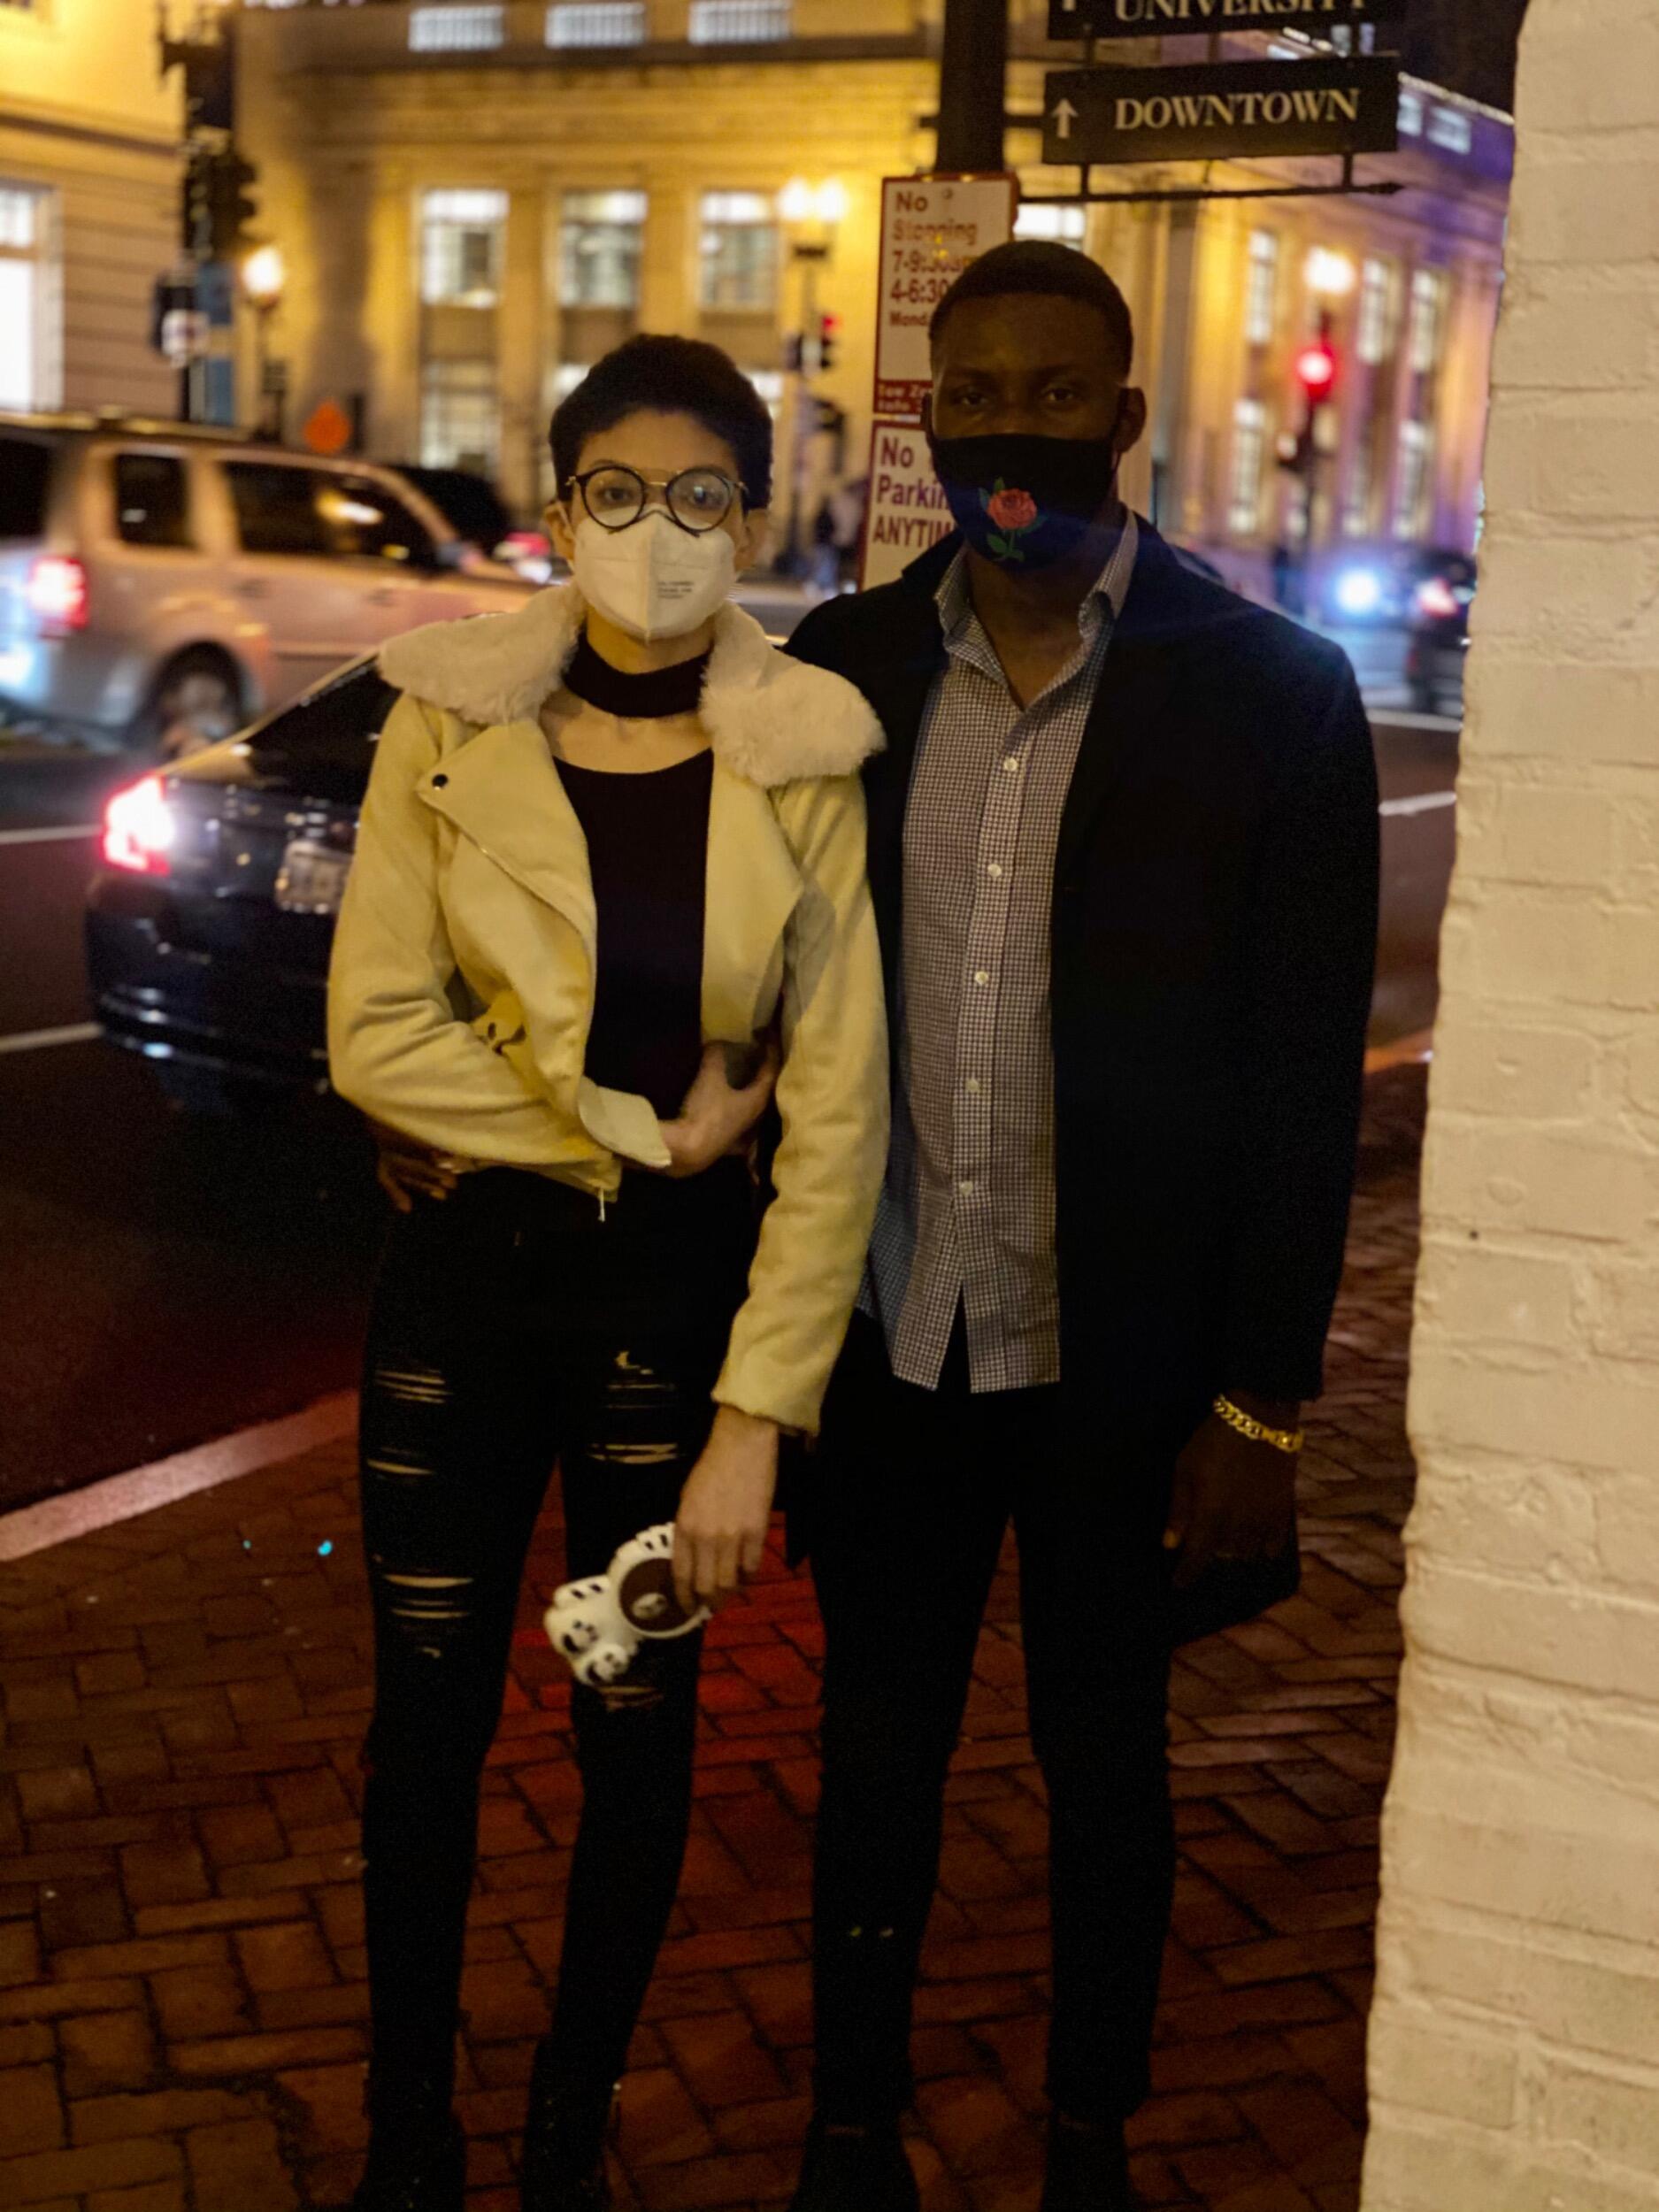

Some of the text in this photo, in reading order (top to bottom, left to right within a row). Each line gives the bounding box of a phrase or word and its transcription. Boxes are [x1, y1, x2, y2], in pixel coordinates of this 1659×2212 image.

[1115, 88, 1360, 130] DOWNTOWN
[895, 191, 928, 212] No
[890, 279, 950, 303] 4-6:30
[889, 311, 928, 326] Mond
[879, 437, 914, 467] No
[876, 475, 950, 510] Parkin
[872, 516, 952, 549] ANYTIM
